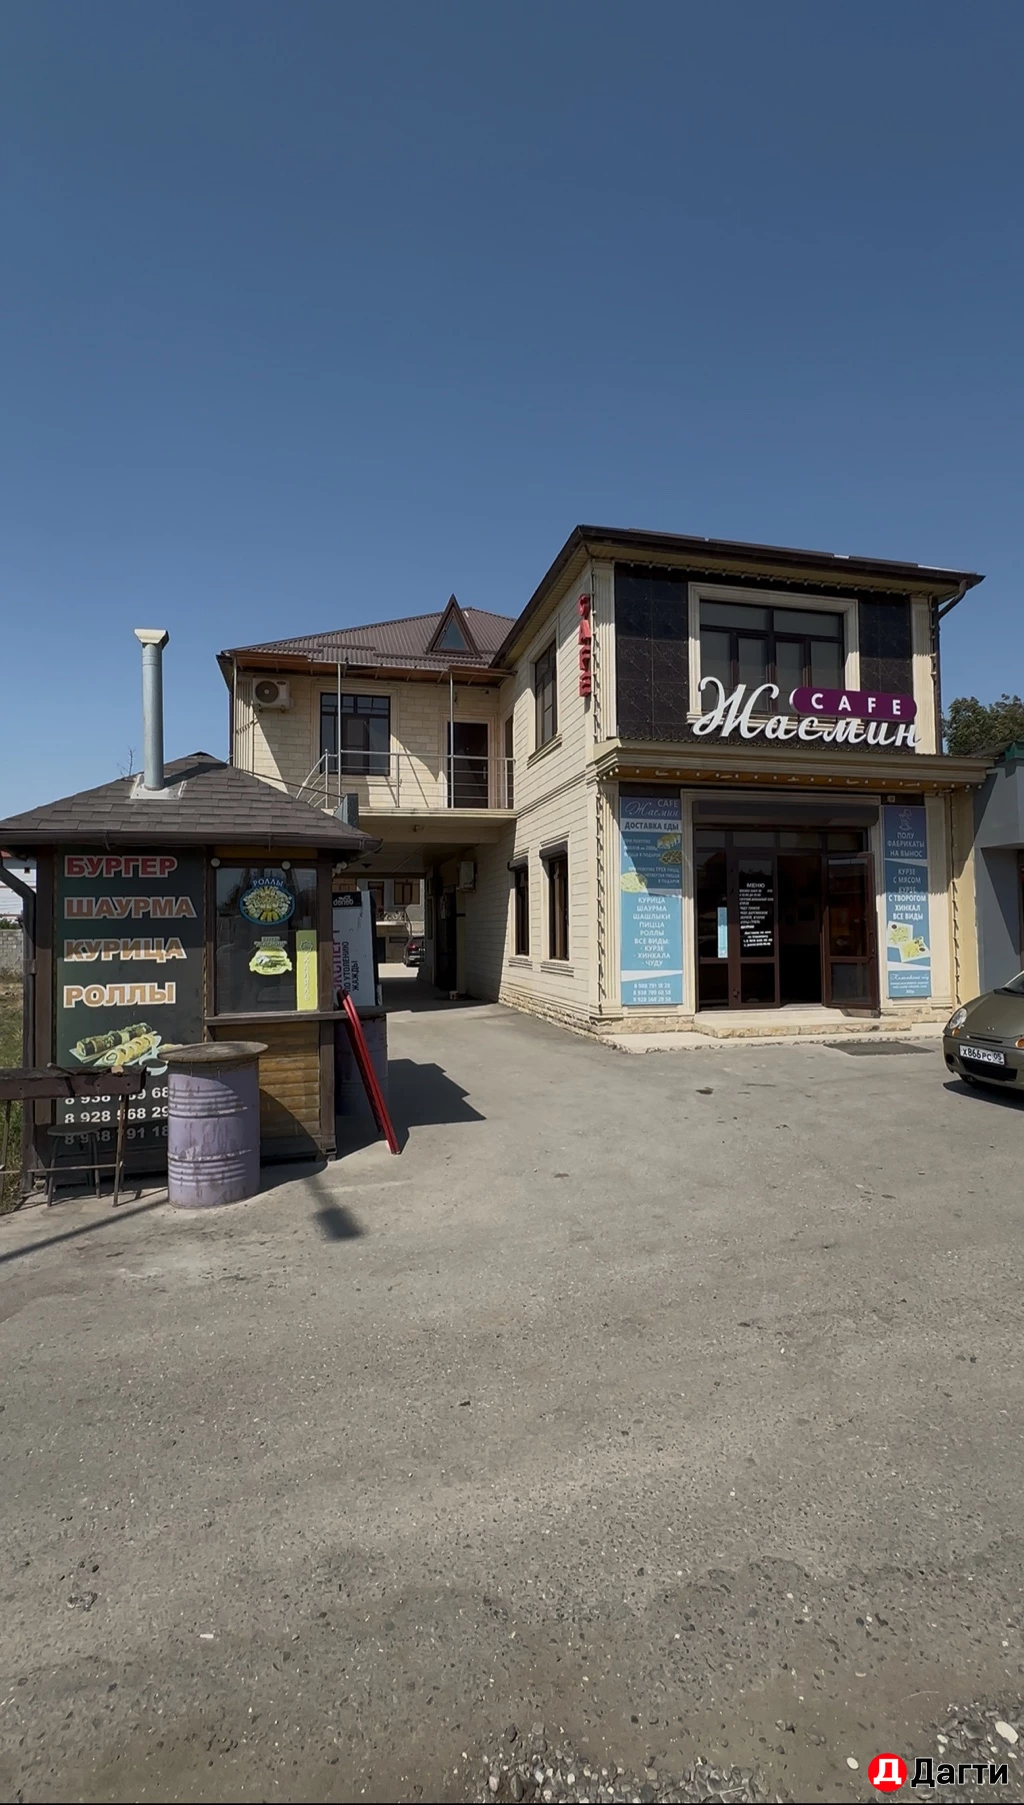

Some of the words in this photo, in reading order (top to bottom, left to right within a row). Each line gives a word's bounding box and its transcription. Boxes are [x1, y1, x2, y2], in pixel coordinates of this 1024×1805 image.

[692, 676, 922, 748] Жасмин
[811, 693, 901, 715] CAFE
[624, 801, 679, 817] Жасмин
[657, 799, 679, 808] CAFE
[624, 821, 662, 830] ДОСТАВКА
[663, 823, 679, 831] ЕДЫ
[64, 855, 178, 878] БУРГЕР
[253, 878, 284, 887] РОЛЛЫ
[898, 876, 921, 884] МЯСОМ
[64, 896, 198, 919] ШАУРМА
[905, 913, 924, 921] ВИДЫ
[64, 937, 187, 963] КУРИЦА
[342, 941, 351, 981] УТОЛЕНИЮ
[351, 960, 360, 991] ЖАЖДЫ
[63, 982, 176, 1008] РОЛЛЫ
[64, 1113, 75, 1124] 8
[80, 1110, 111, 1122] 928
